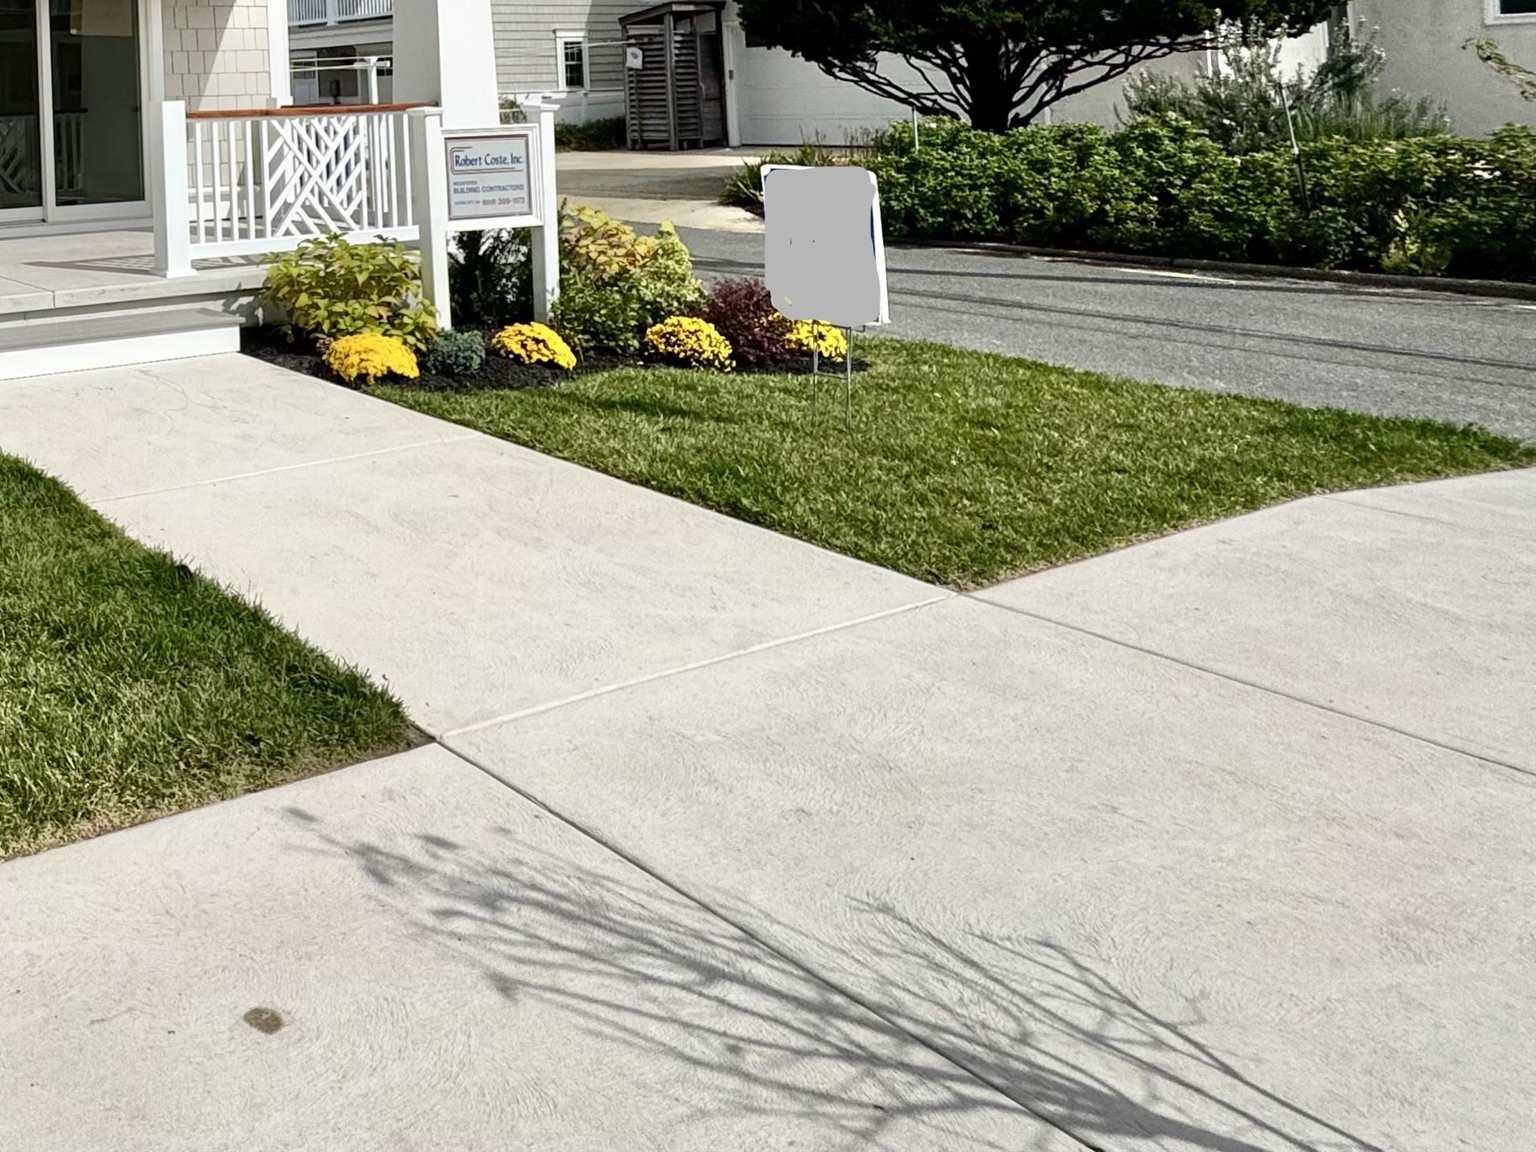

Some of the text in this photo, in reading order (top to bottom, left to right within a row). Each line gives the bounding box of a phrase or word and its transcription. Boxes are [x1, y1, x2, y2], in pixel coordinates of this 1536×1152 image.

[455, 154, 482, 167] Robert
[453, 184, 524, 194] BUILDING CONTRACTORS
